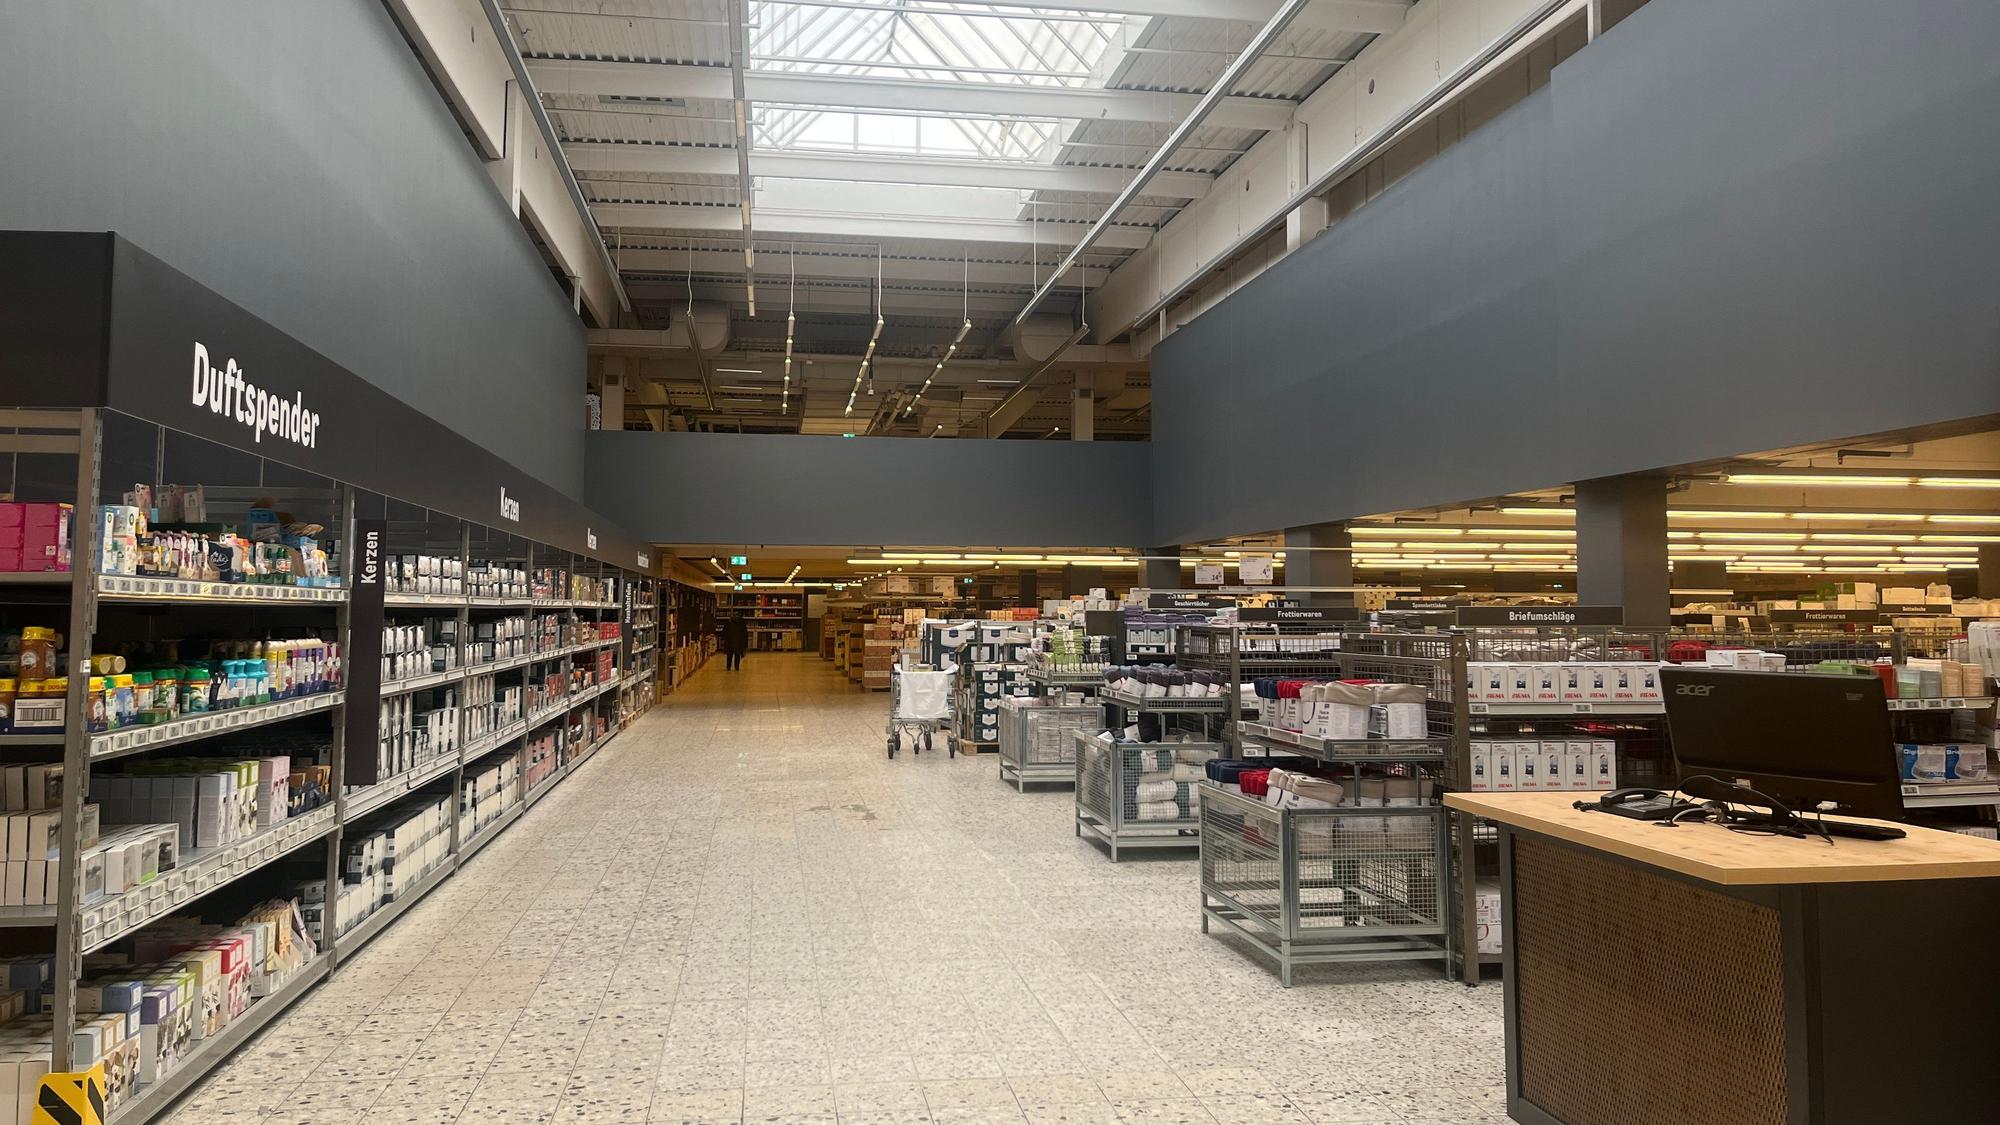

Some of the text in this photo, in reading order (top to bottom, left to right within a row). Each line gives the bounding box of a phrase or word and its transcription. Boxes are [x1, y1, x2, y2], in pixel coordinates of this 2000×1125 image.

[192, 341, 320, 449] Duftspender
[500, 486, 520, 522] Kerzen
[360, 531, 379, 584] Kerzen
[1277, 610, 1323, 619] Frottierwaren
[1508, 611, 1576, 623] Briefumschläge
[1805, 612, 1846, 620] Frottierwaren
[1675, 684, 1716, 696] acer
